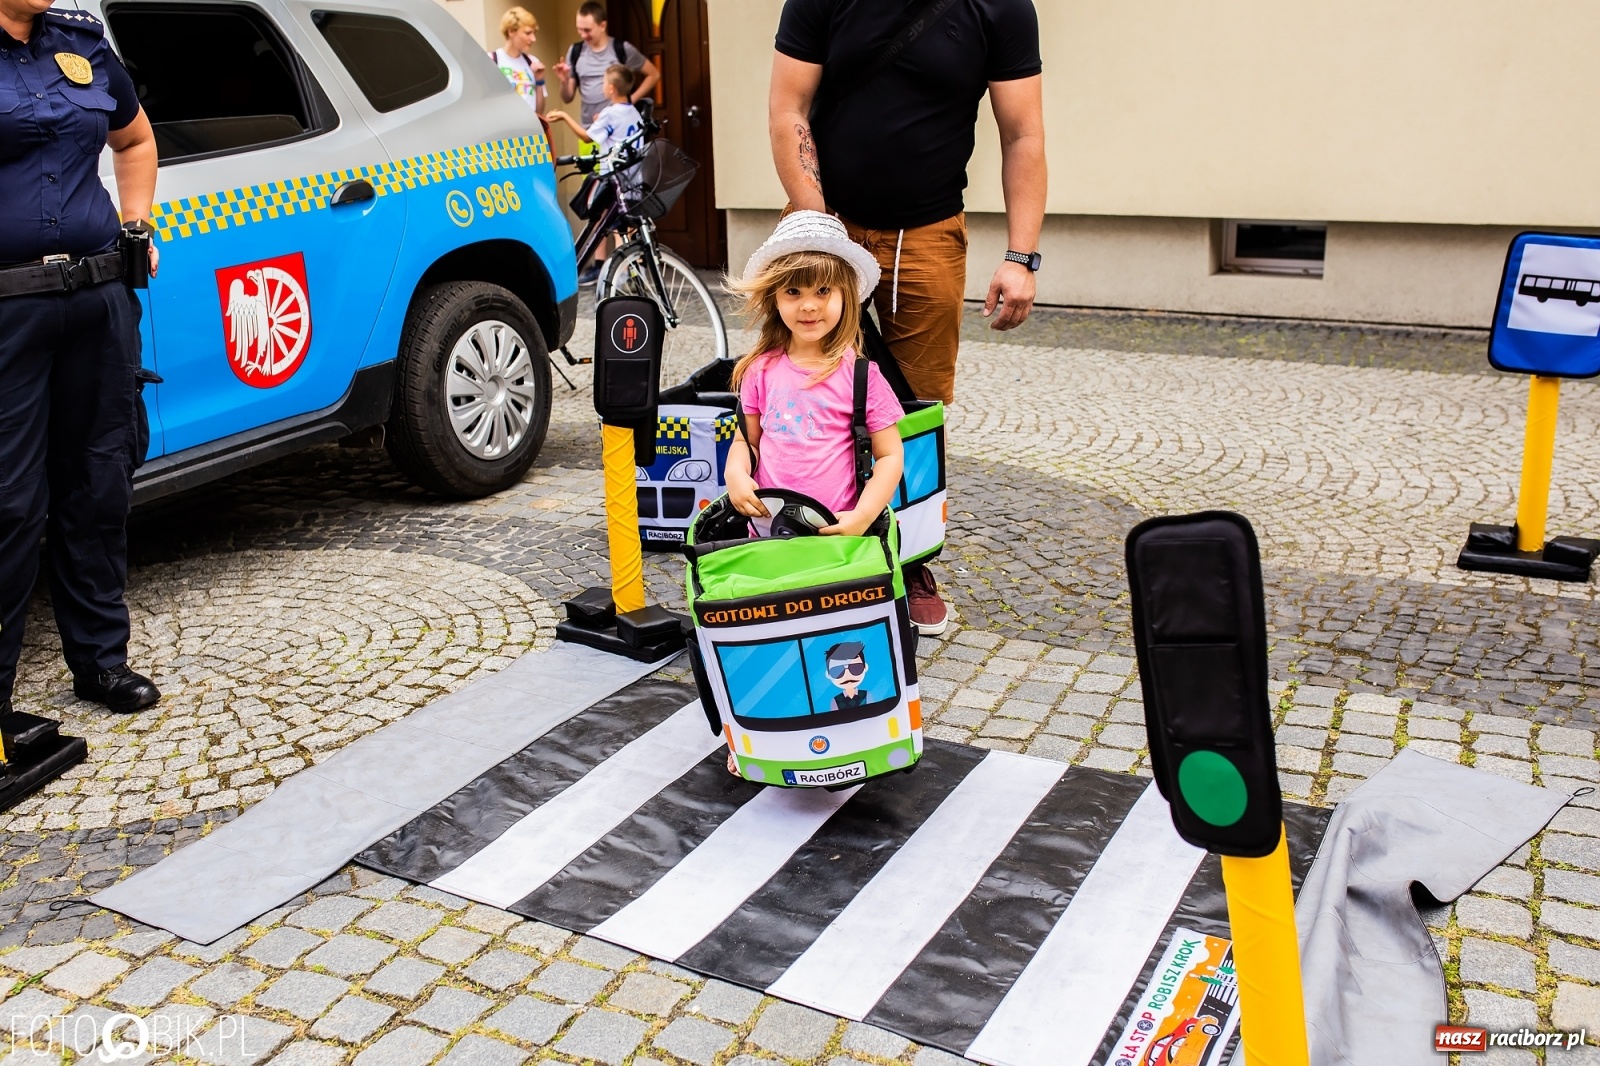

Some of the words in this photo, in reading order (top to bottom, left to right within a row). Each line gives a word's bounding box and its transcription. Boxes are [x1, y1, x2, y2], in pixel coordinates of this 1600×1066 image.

[476, 181, 521, 218] 986
[648, 531, 684, 540] RACIBÓRZ
[704, 604, 779, 624] GOTOWI
[785, 599, 813, 616] DO
[821, 586, 886, 609] DROGI
[800, 767, 861, 783] RACIBÓRZ
[1130, 1011, 1156, 1043] STOP
[1147, 968, 1182, 1010] ROBISZ
[1170, 939, 1201, 968] KROK
